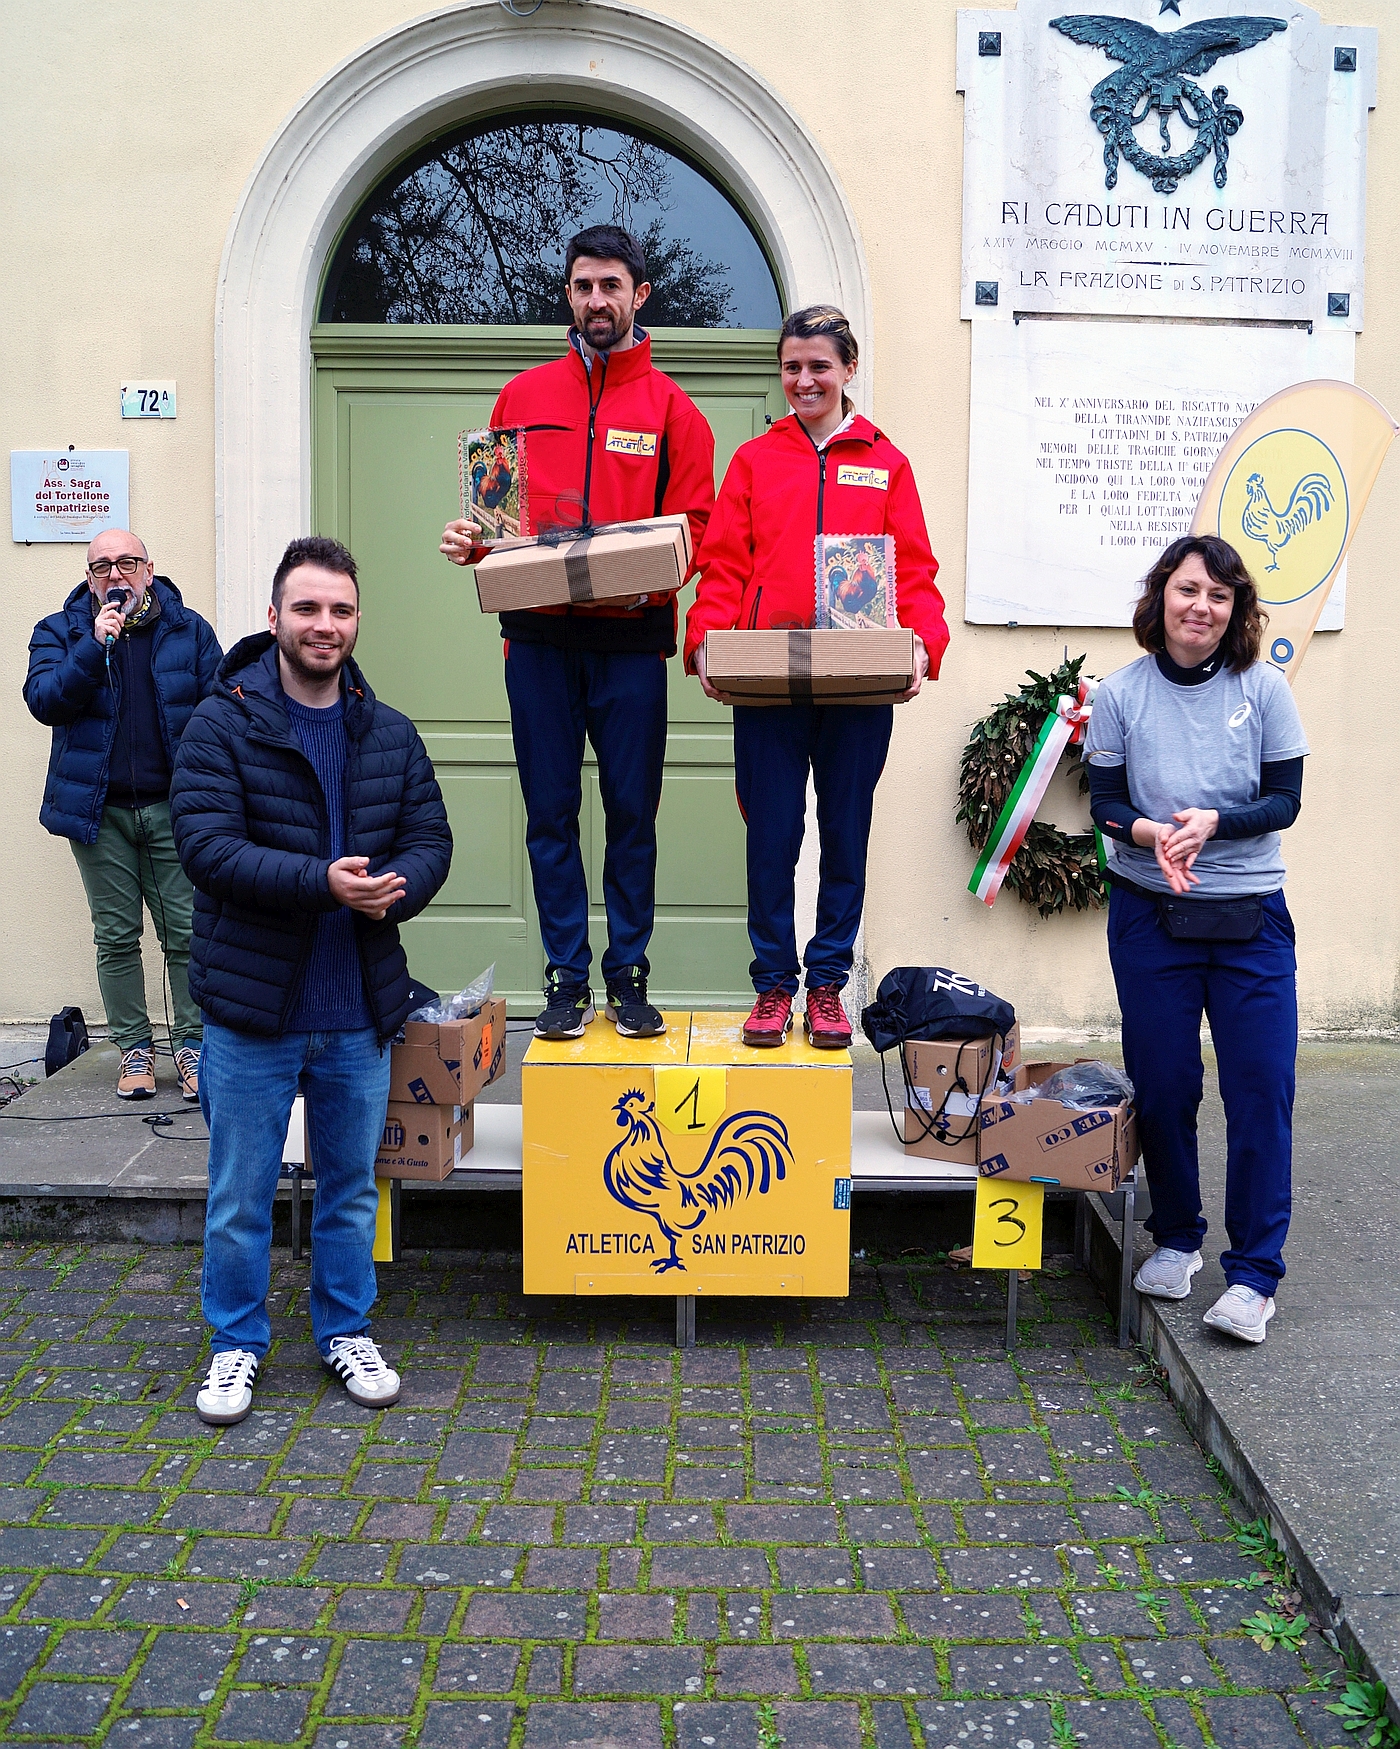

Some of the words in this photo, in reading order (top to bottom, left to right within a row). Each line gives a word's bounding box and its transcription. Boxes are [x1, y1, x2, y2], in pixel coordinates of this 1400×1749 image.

[1001, 201, 1028, 225] AI
[1045, 203, 1149, 229] CADUTI
[1163, 206, 1190, 230] IN
[1206, 208, 1329, 235] GUERRA
[983, 237, 1015, 248] XXIV
[1025, 237, 1083, 251] MAGGIO
[1095, 240, 1153, 253] MCMXV
[1179, 243, 1192, 254] IV
[1198, 244, 1280, 258] NOVEMBRE
[1289, 247, 1354, 261] MCMXVIII
[1020, 270, 1049, 287] LA
[1060, 271, 1163, 290] FRAZIONE
[1173, 279, 1184, 291] DI
[1034, 397, 1053, 408] NEL
[1072, 397, 1149, 411] ANNIVERSARIO
[1155, 400, 1175, 411] DEL
[1182, 400, 1230, 412] RISCATTO
[1074, 413, 1108, 424] DELLA
[1115, 413, 1171, 426] TIRANNIDE
[1177, 415, 1245, 428] NAZIFASCIST
[1099, 428, 1149, 440] CITTADINI
[1155, 430, 1166, 441] DI
[1184, 431, 1229, 443] PATRIZIO
[1040, 442, 1077, 454] MEMORI
[1087, 443, 1119, 455] DELLE
[1127, 444, 1177, 457] TRAGICHE
[1183, 446, 1224, 458] GIORNA
[1035, 457, 1054, 469] NEL
[1058, 458, 1091, 470] TEMPO
[1096, 459, 1133, 471] TRISTE
[1140, 460, 1173, 472] DELLA
[44, 479, 66, 488] Ass.
[70, 479, 101, 490] Sagra
[1055, 473, 1099, 485] INCIDONO
[1107, 474, 1123, 487] QUI
[1131, 475, 1144, 486] LA
[1150, 475, 1176, 487] LORO
[1181, 476, 1207, 488] VOLO
[35, 490, 52, 500] del
[55, 490, 110, 500] Tortellone
[1070, 489, 1077, 500] E
[1082, 489, 1096, 500] LA
[1103, 489, 1129, 501] LORO
[36, 503, 110, 514] Sanpatriziese
[1059, 503, 1078, 514] PER
[1100, 504, 1131, 517] QUALI
[1110, 520, 1142, 532] NELLA
[1148, 521, 1190, 533] RESISTE
[1110, 535, 1136, 547] LORO
[1142, 536, 1168, 547] FIGLI
[674, 1077, 706, 1130] 1
[398, 1157, 406, 1166] di
[407, 1158, 429, 1168] Gusto
[988, 1198, 1027, 1246] 3
[565, 1233, 656, 1255] ATLETICA
[692, 1233, 730, 1256] SAN
[731, 1233, 806, 1256] PATRIZIO
